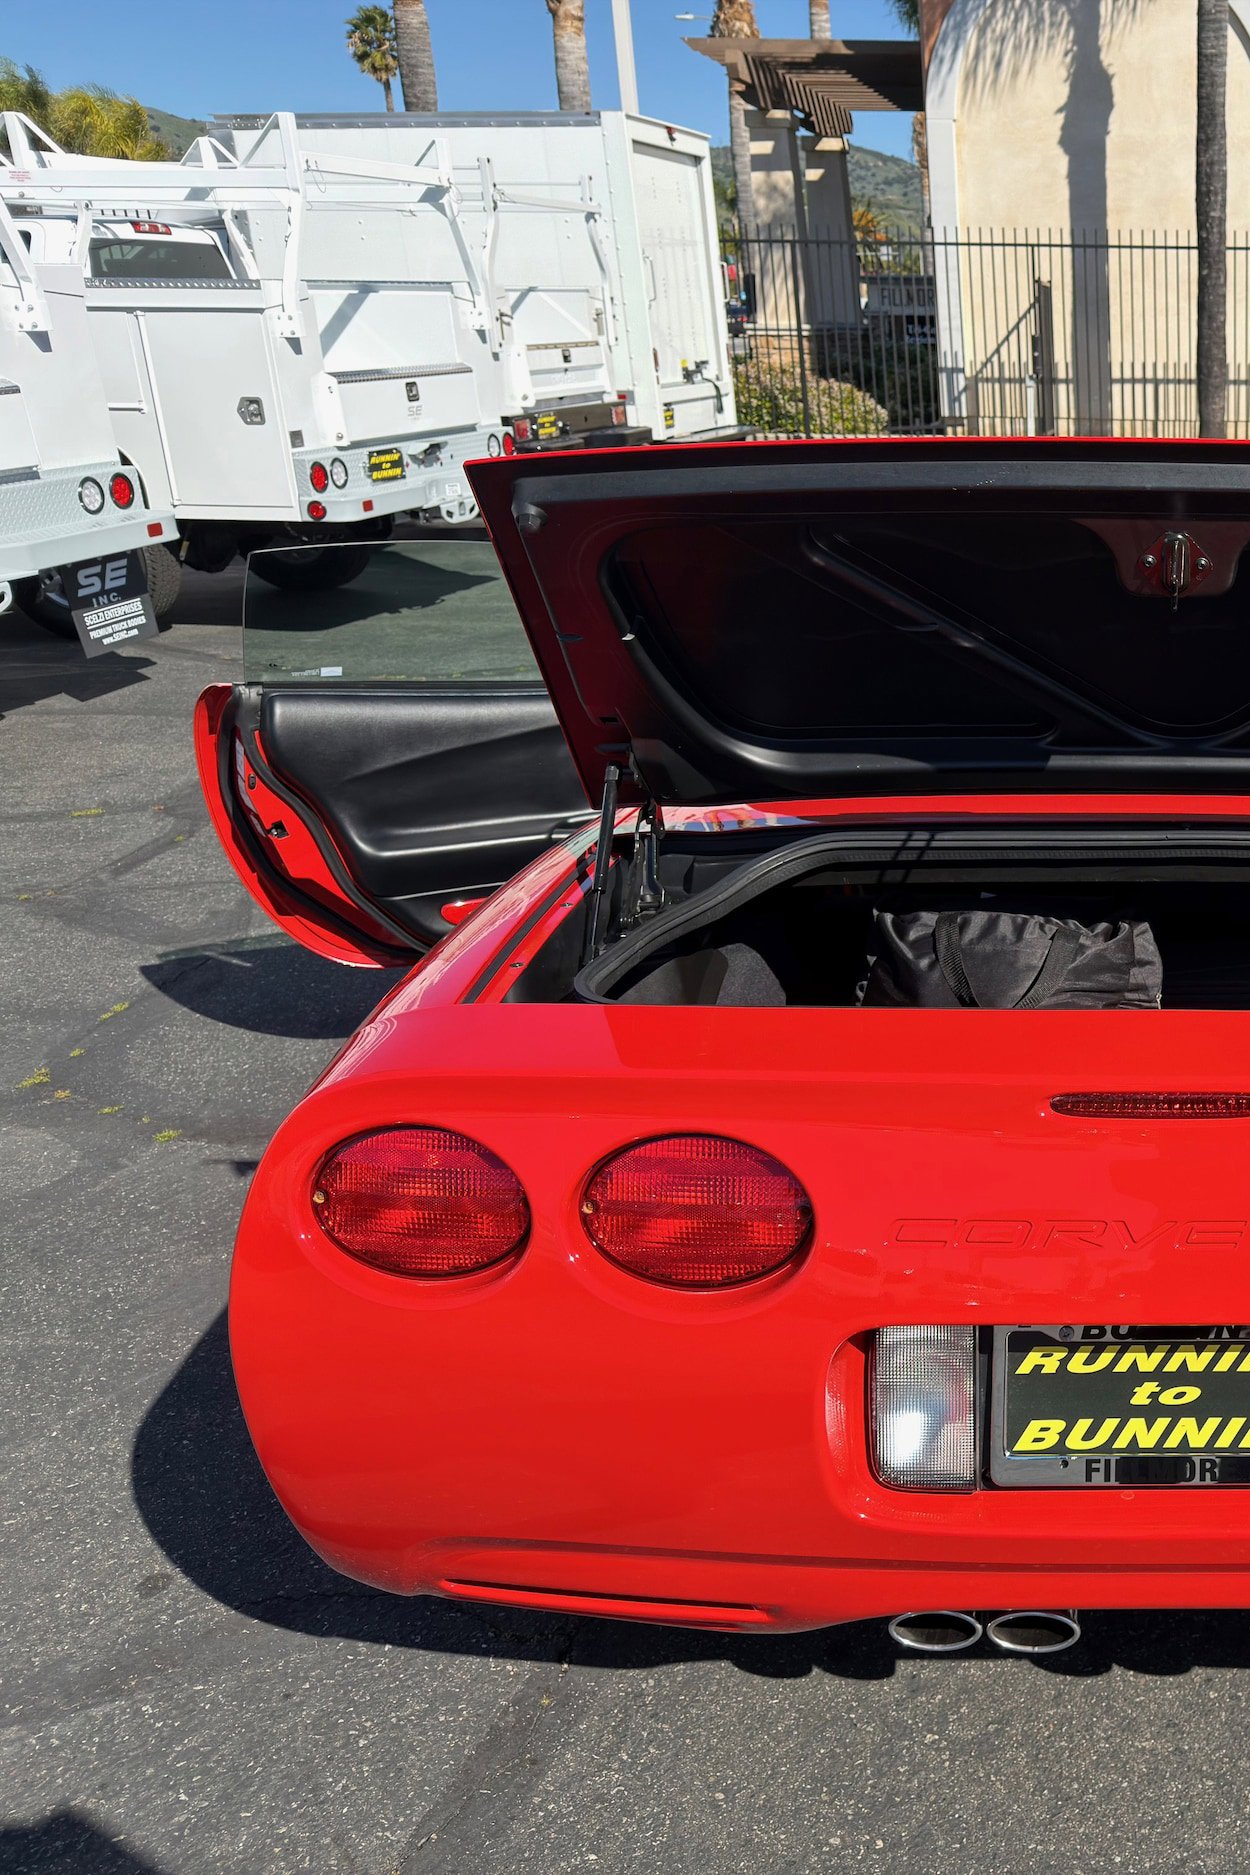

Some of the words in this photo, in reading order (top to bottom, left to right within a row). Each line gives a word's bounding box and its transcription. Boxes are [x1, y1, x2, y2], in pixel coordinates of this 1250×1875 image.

[77, 558, 128, 598] SE
[92, 592, 122, 608] INC.
[104, 601, 143, 621] ENTERPRISES
[89, 625, 114, 640] PREMIUM
[112, 620, 128, 633] TRUCK
[126, 615, 146, 628] BODIES
[1129, 1381, 1202, 1406] to
